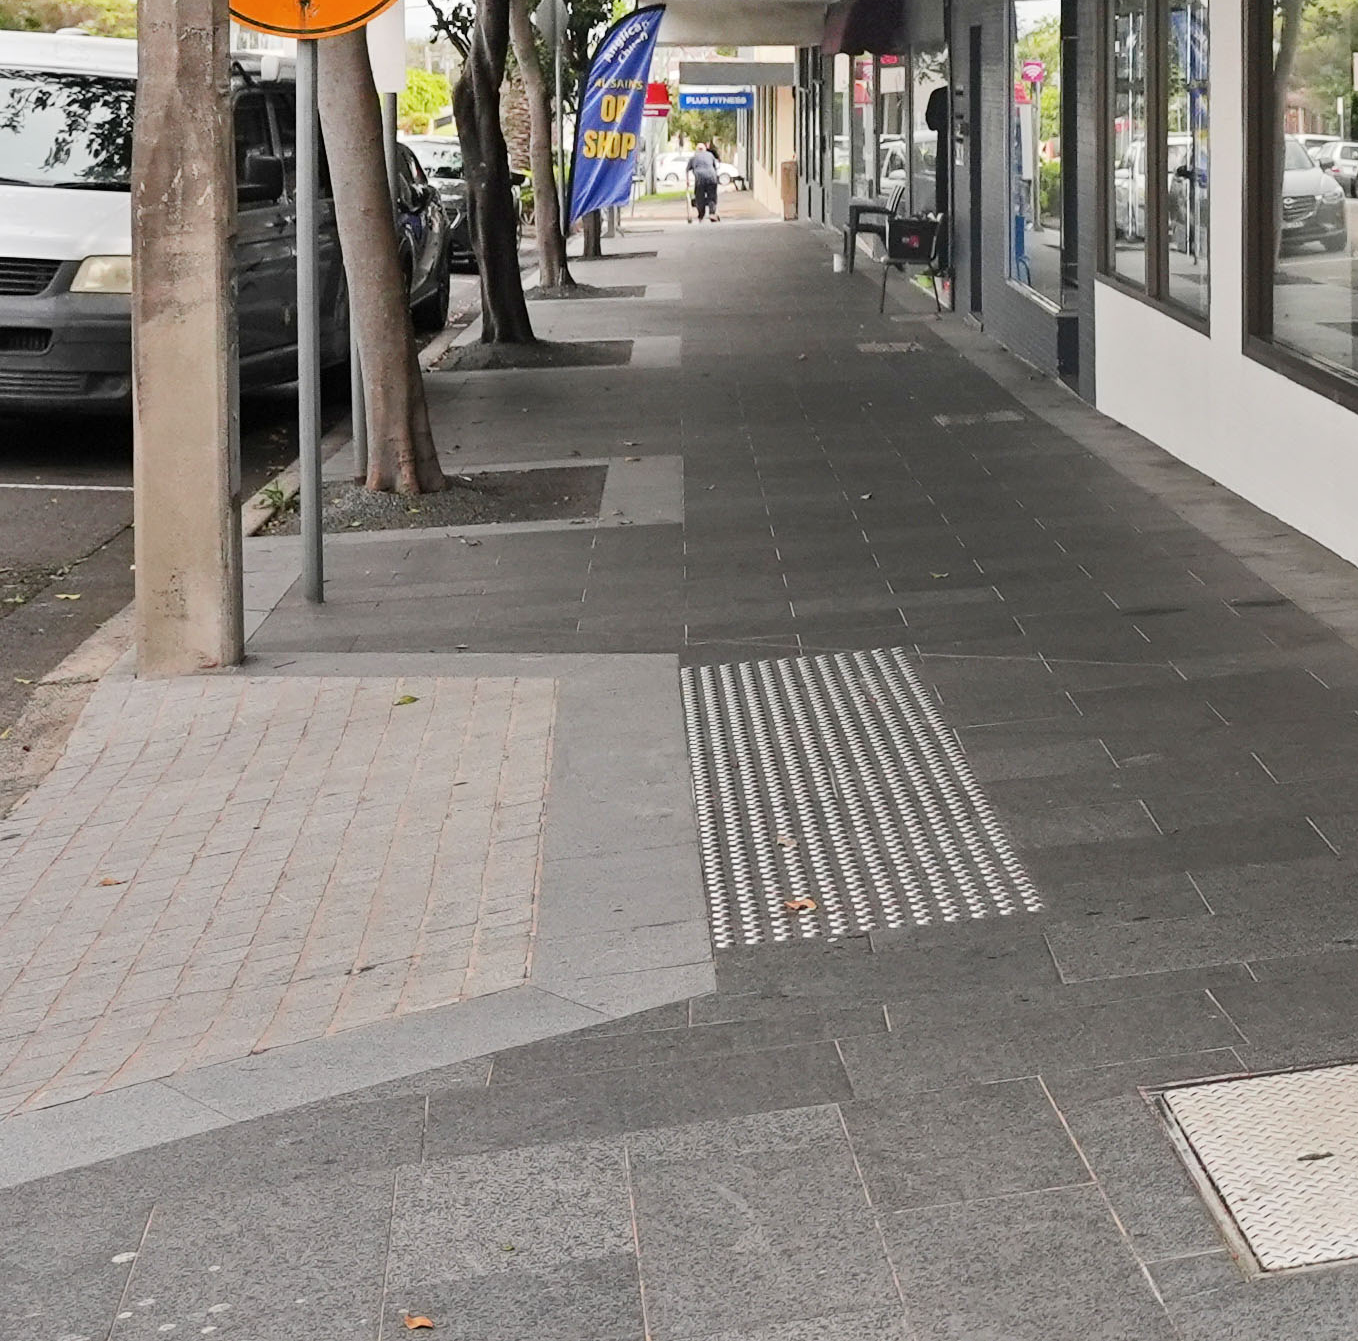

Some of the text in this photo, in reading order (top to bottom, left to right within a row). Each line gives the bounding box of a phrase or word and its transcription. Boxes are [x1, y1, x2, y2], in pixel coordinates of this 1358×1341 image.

[600, 94, 629, 123] OP
[685, 96, 747, 105] PLUS FITNESS
[582, 129, 637, 160] SHOP
